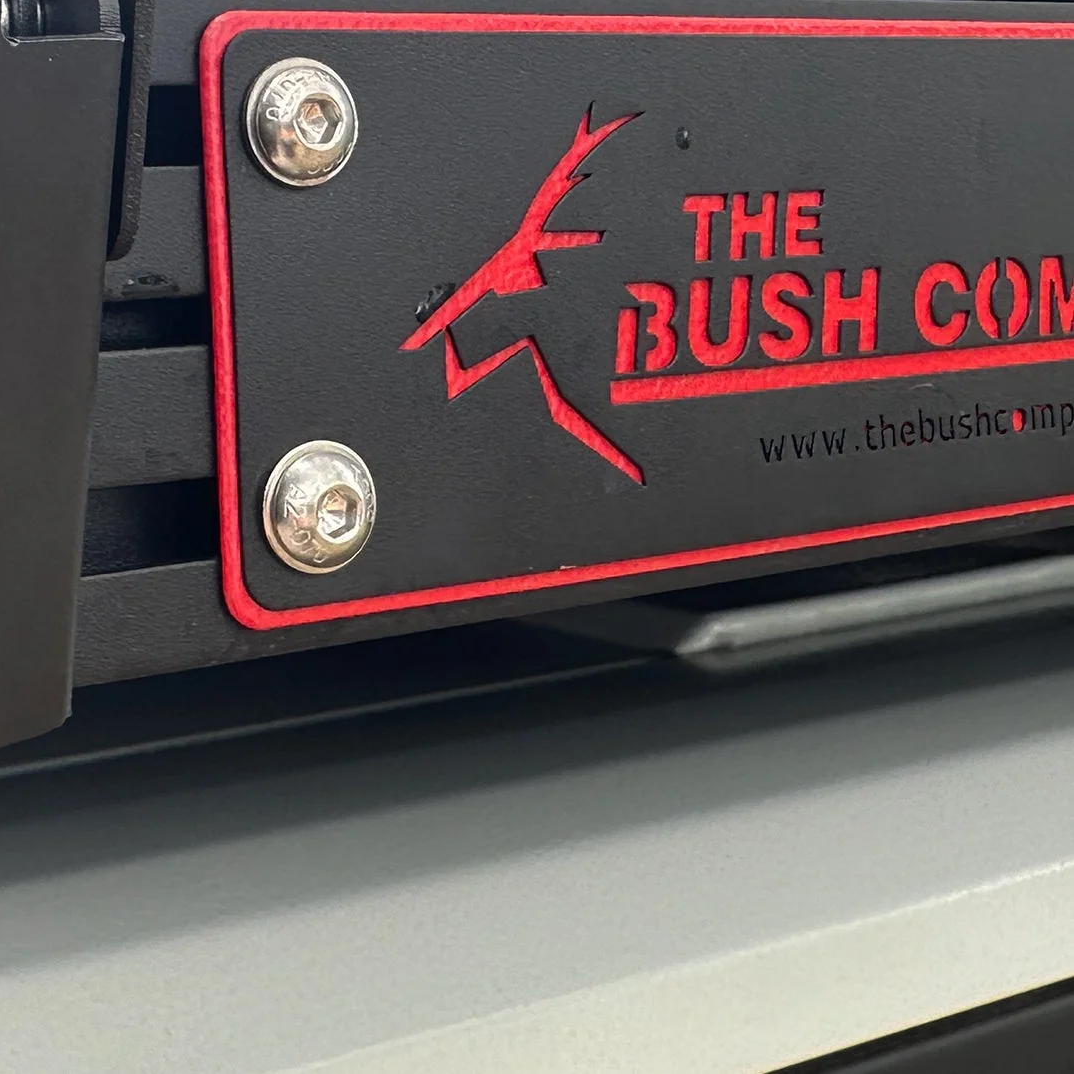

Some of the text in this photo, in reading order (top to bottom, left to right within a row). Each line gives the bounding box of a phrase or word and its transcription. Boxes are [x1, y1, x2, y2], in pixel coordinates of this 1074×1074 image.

[682, 190, 824, 263] THE
[615, 254, 1074, 374] BUSH COM
[760, 402, 1074, 463] www.thebushcomp
